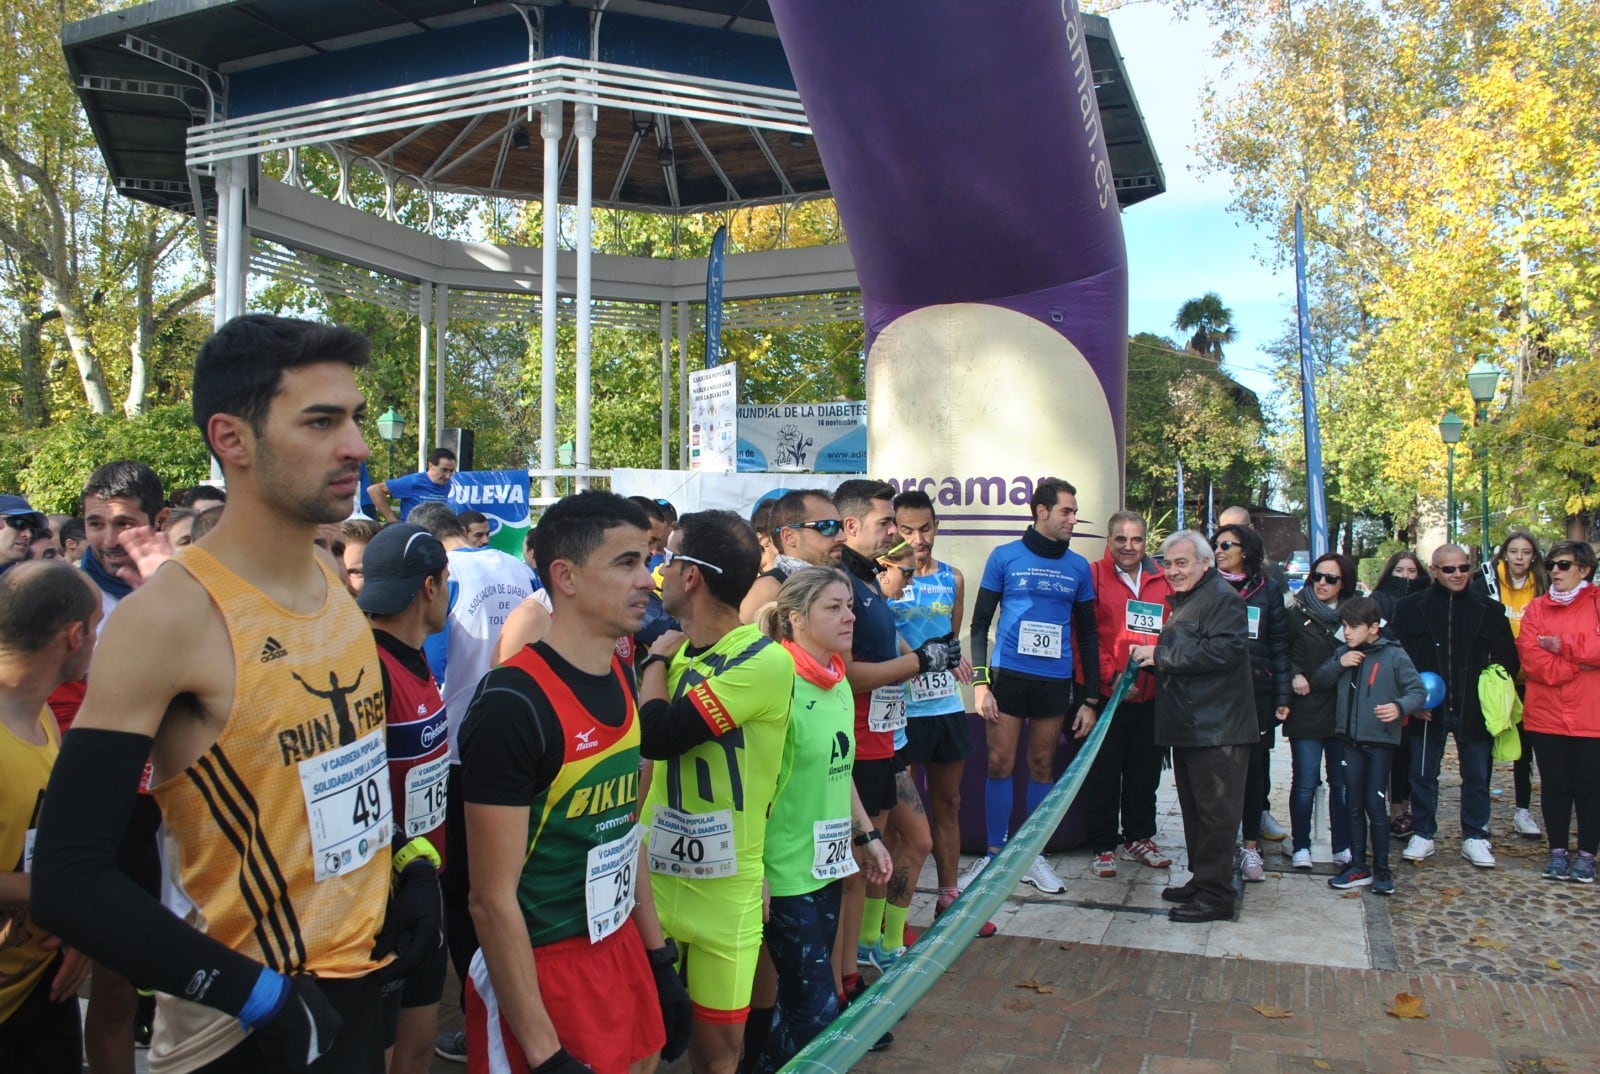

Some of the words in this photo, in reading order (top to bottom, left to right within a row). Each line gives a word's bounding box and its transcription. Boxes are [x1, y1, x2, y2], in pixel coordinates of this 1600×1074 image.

[784, 406, 798, 418] DE
[801, 405, 815, 417] LA
[817, 404, 867, 417] DIABETES
[825, 418, 858, 427] noviembre
[1133, 614, 1154, 627] 733
[1033, 634, 1050, 648] 30
[261, 649, 288, 663] adidas
[922, 672, 948, 690] 153
[278, 713, 335, 767] RUN
[321, 760, 328, 772] V
[329, 749, 361, 770] CARRERA
[313, 770, 355, 795] SOLIDARIA
[353, 778, 381, 828] 49
[697, 823, 728, 835] DIABETES
[671, 836, 705, 863] 40
[614, 863, 631, 907] 29
